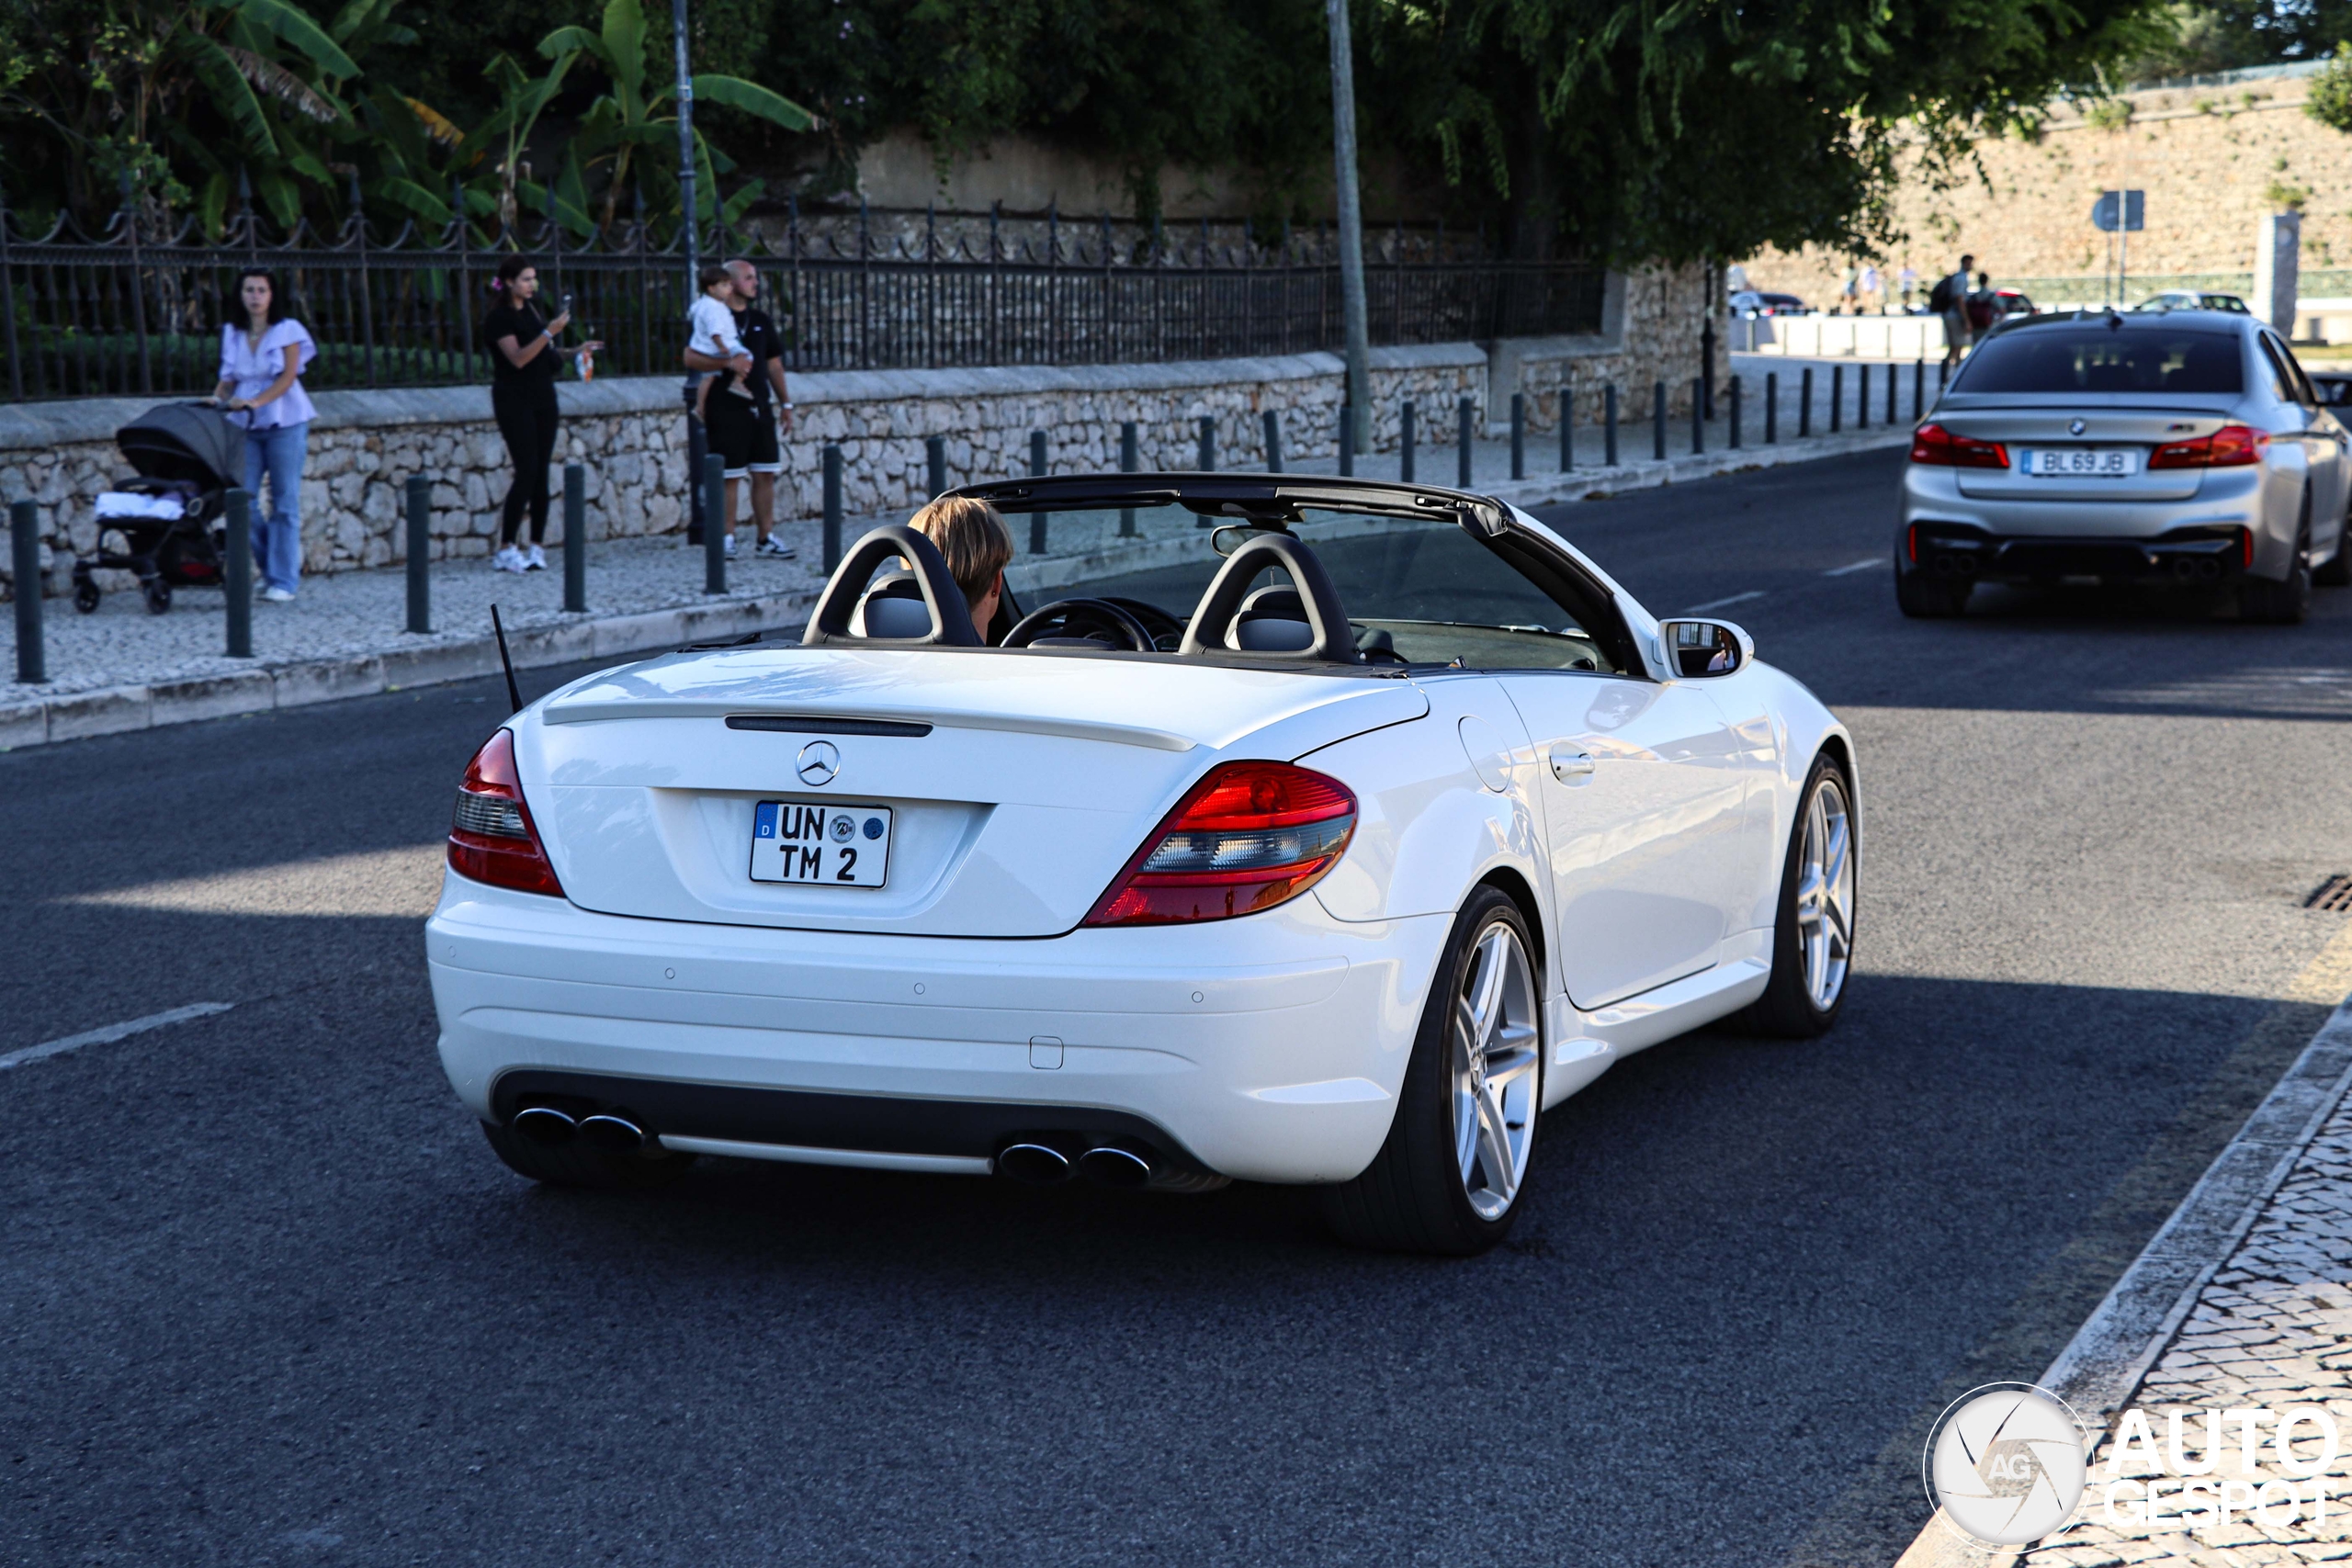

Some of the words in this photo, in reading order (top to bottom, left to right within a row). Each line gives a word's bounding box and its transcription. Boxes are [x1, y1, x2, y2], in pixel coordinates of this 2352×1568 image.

[2044, 453, 2068, 470] BL
[2072, 453, 2096, 470] 69
[2099, 453, 2124, 471] JB
[762, 825, 770, 836] D
[781, 806, 826, 840] UN
[779, 844, 822, 879] TM
[836, 847, 858, 881] 2
